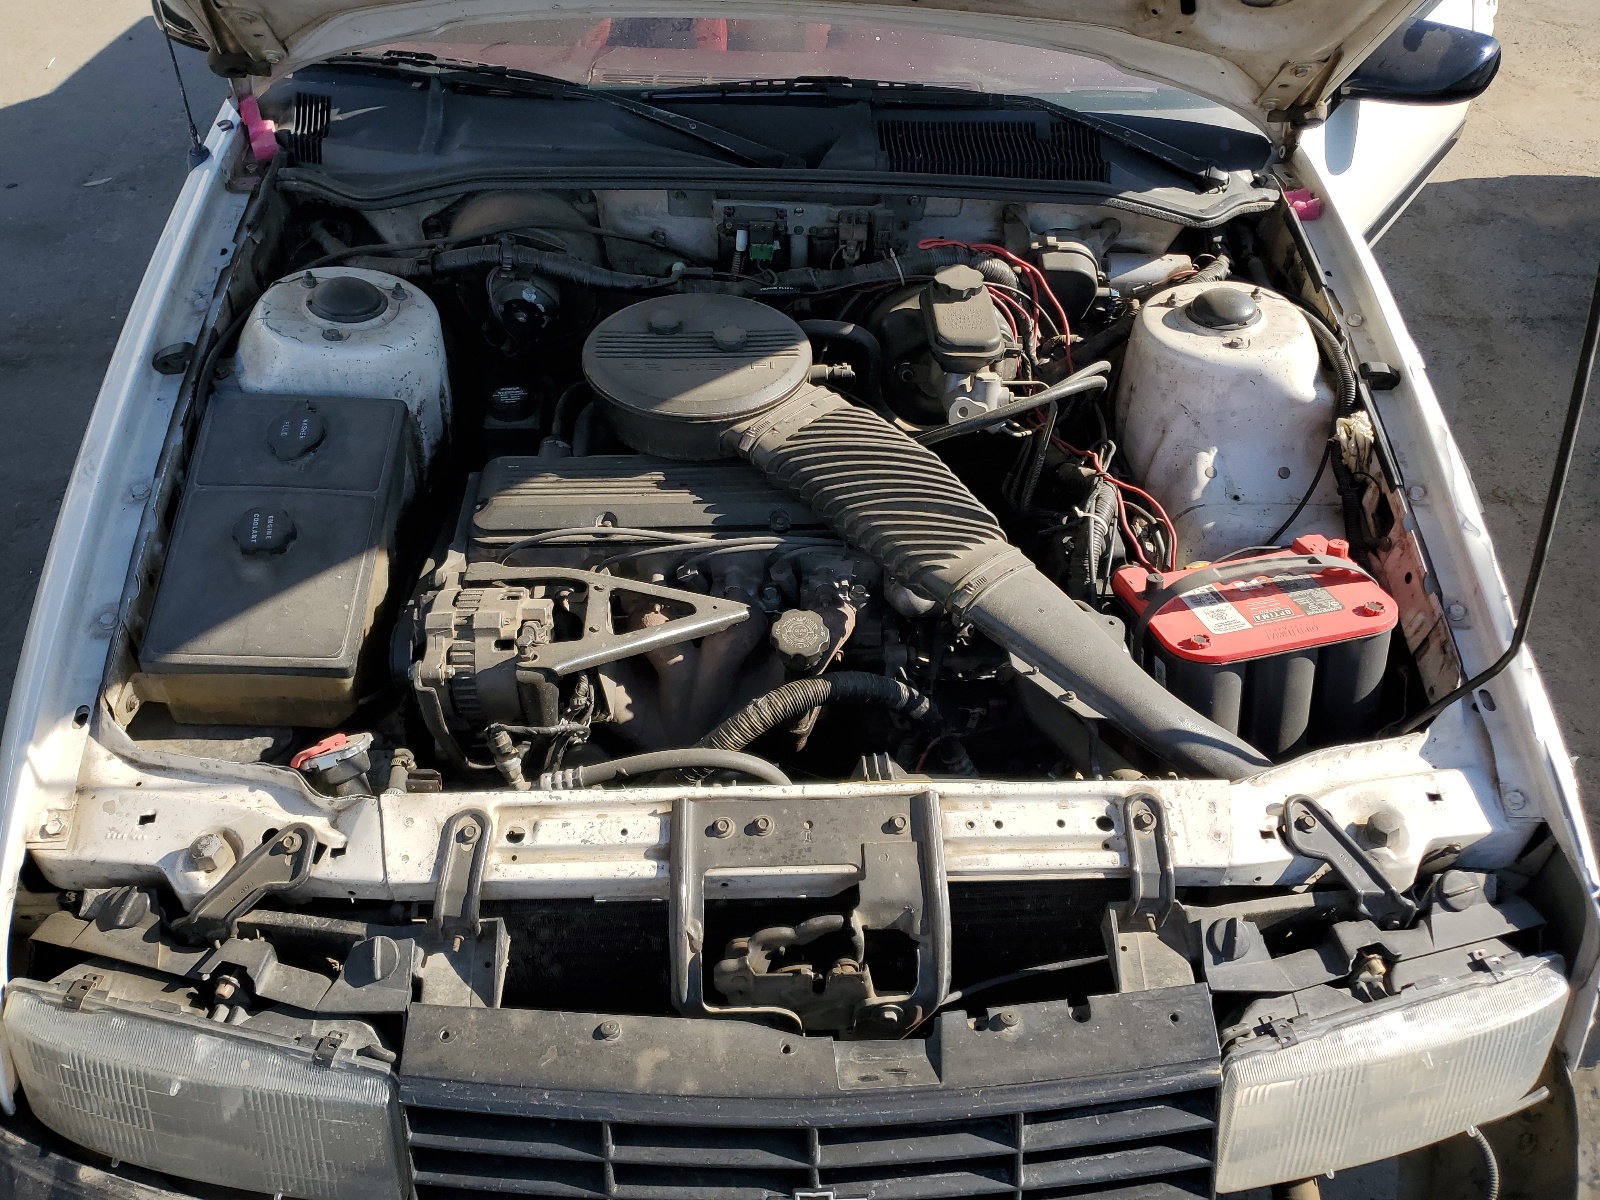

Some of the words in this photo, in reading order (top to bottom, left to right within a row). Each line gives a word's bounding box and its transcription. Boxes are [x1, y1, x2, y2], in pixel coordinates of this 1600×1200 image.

[250, 513, 260, 543] COOLANT
[265, 515, 274, 540] ENGINE
[1254, 608, 1292, 622] OPTIMA
